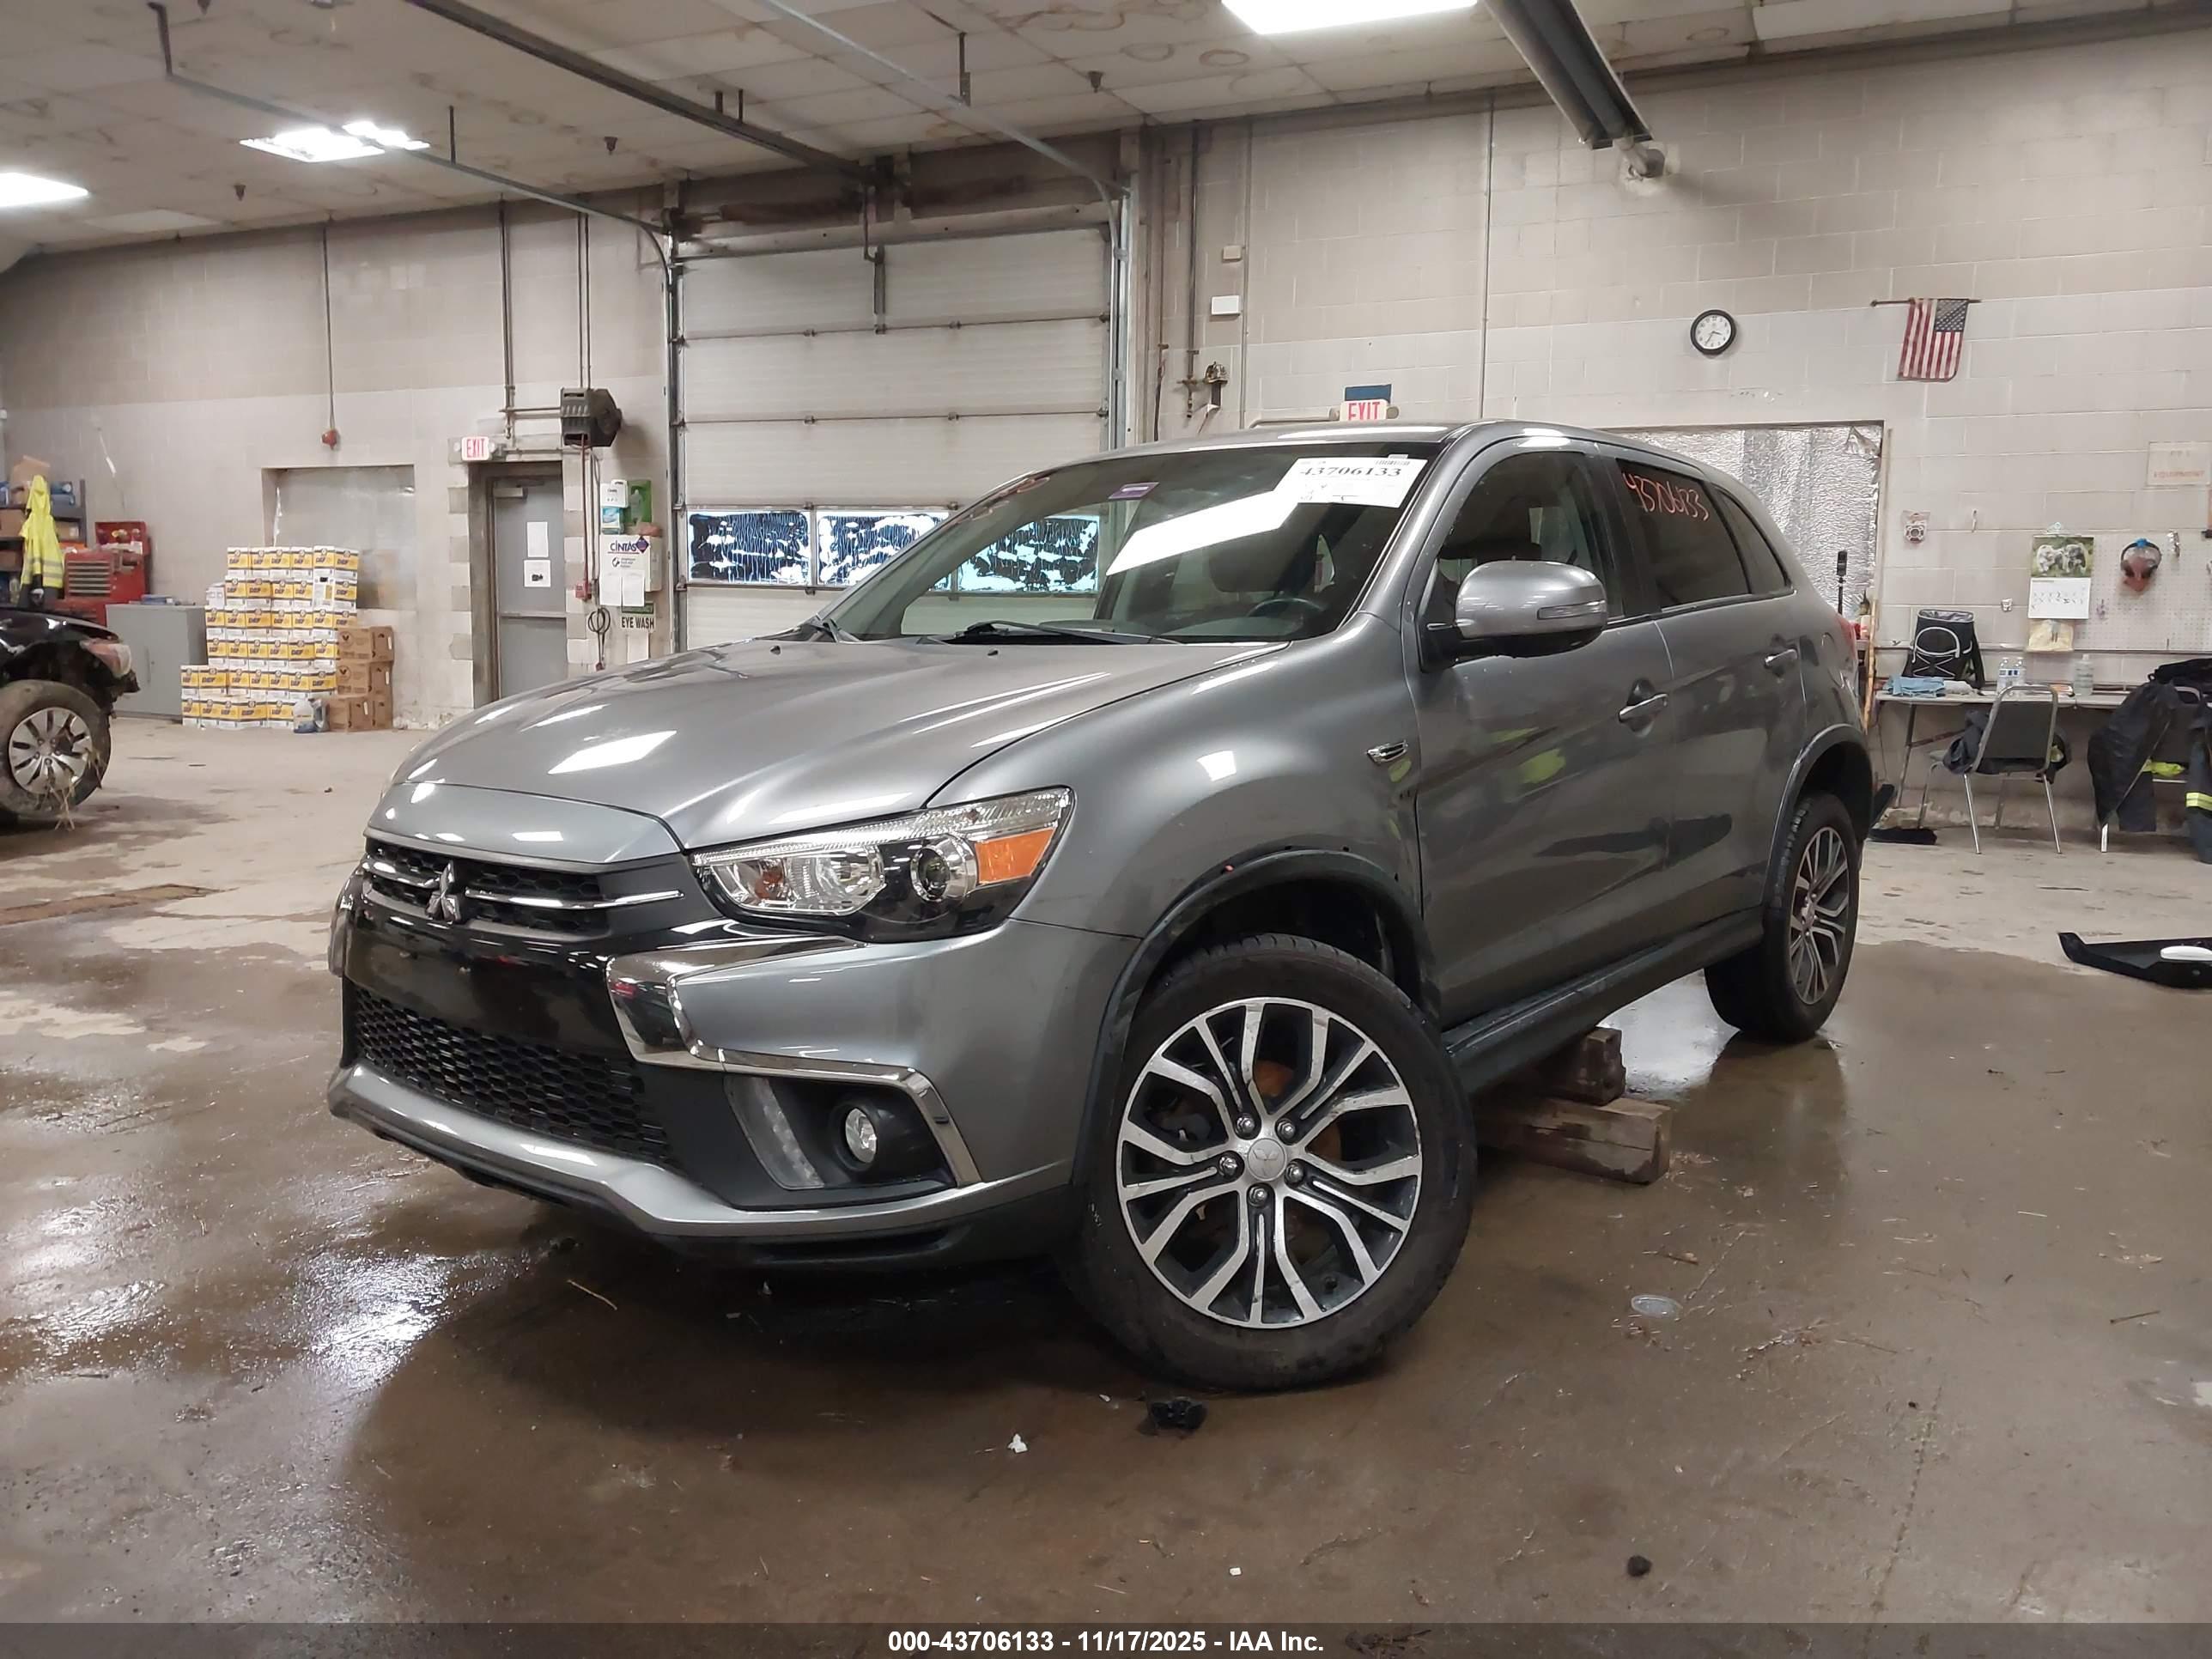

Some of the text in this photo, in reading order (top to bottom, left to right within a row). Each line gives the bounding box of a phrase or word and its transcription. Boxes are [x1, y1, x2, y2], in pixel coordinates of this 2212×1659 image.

[1348, 401, 1380, 421] EXIT
[467, 438, 485, 458] EXIT
[1300, 466, 1402, 477] 43706133
[1622, 471, 1709, 521] 43706133
[622, 617, 654, 629] EYE WASH
